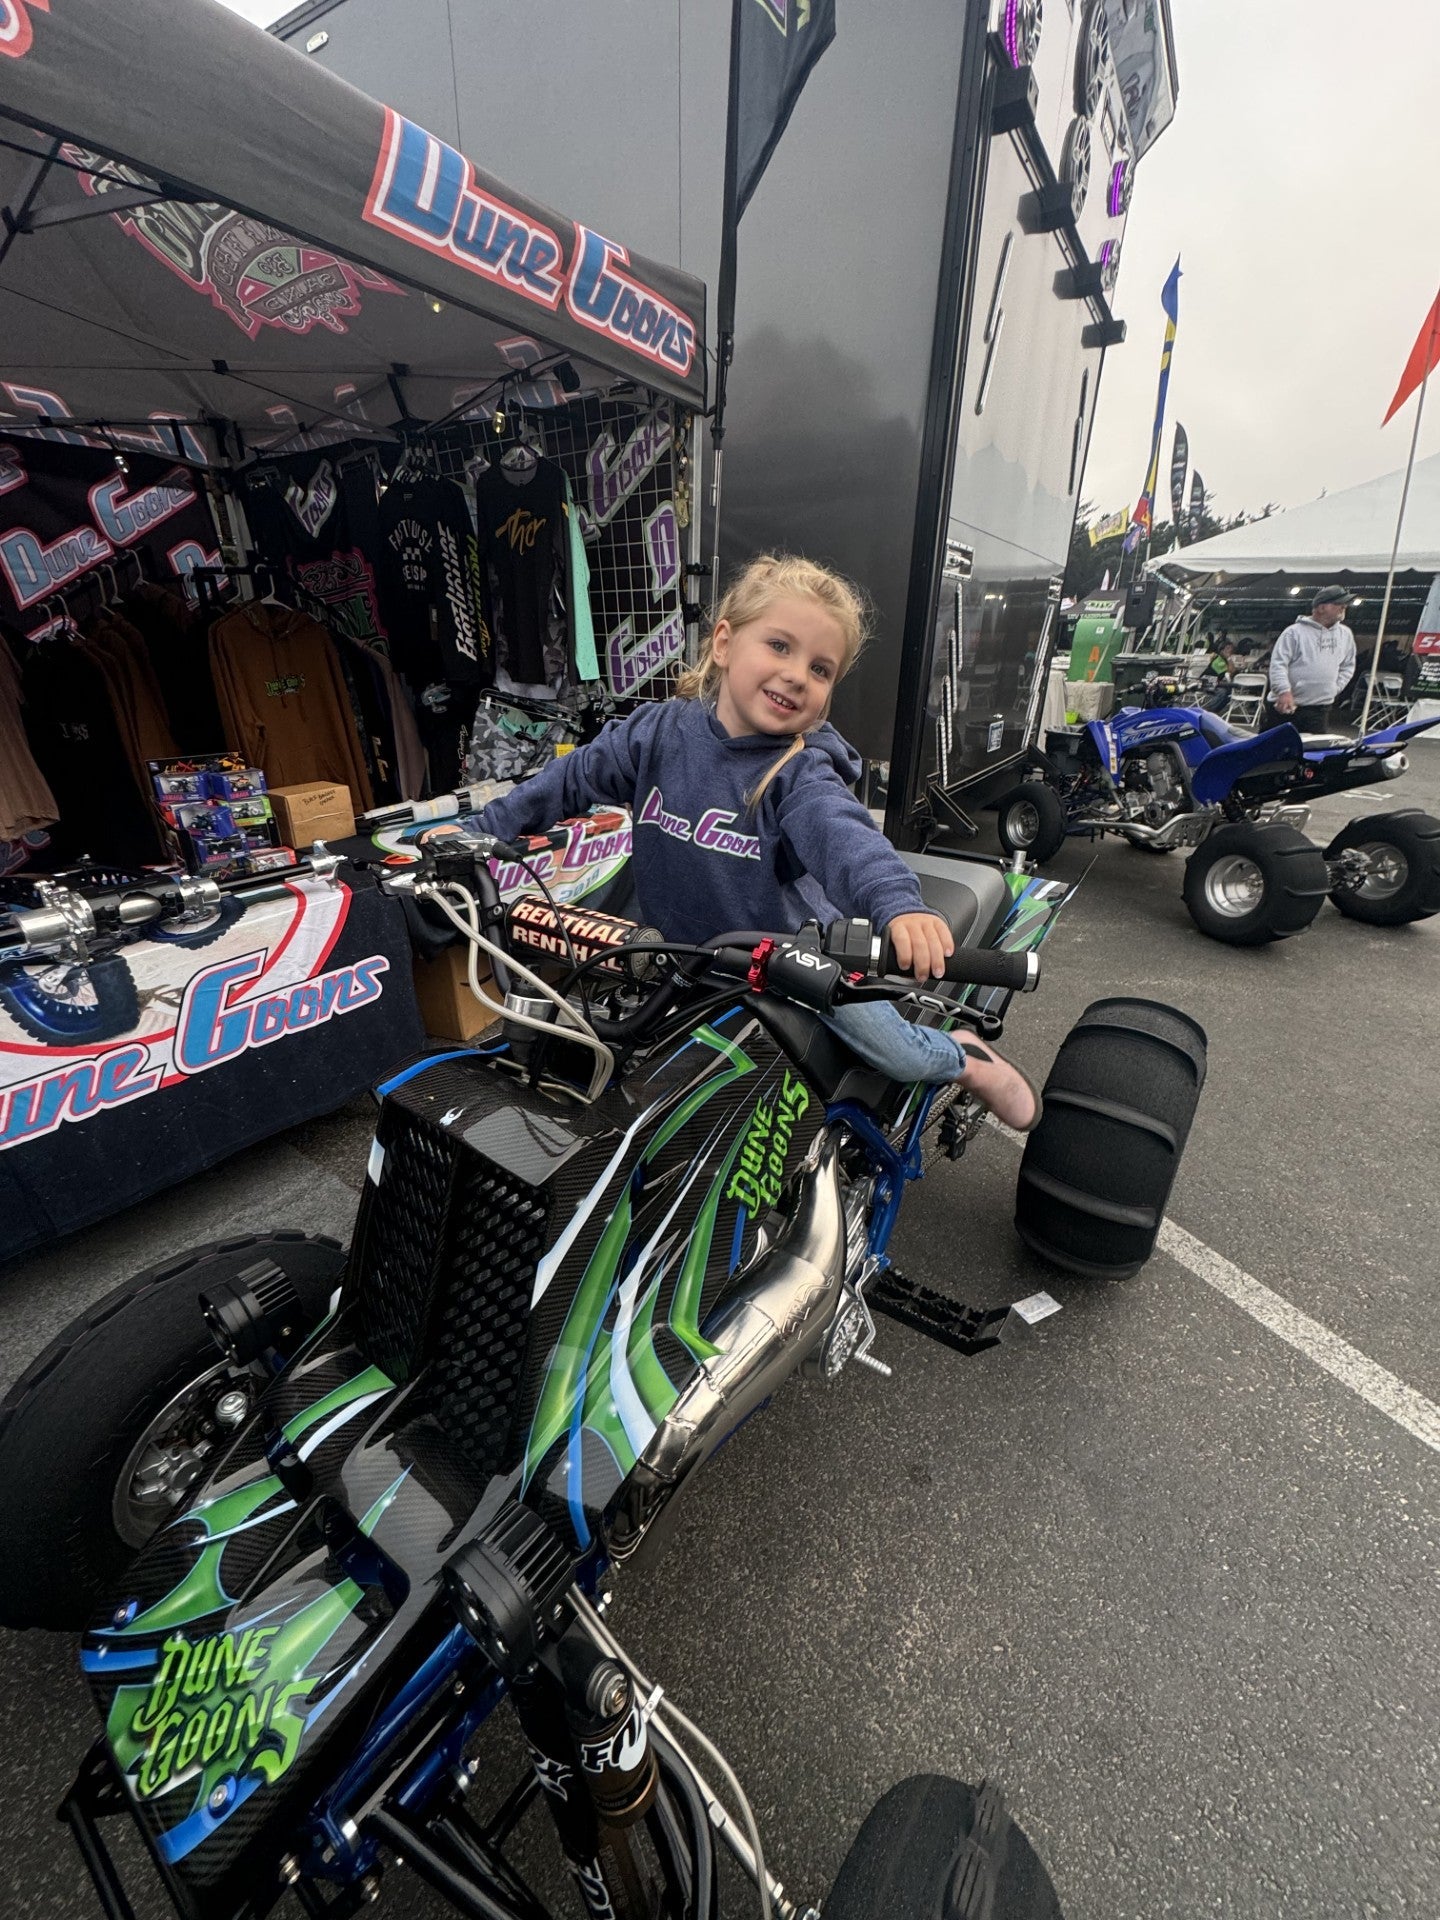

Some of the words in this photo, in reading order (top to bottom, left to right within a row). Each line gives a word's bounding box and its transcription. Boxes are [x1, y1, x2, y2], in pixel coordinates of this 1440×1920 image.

[364, 106, 564, 310] Dune
[564, 222, 697, 377] Goons
[0, 522, 115, 612] Dune
[560, 820, 633, 873] Goon
[637, 786, 693, 842] Dune
[693, 808, 761, 860] Goon
[511, 902, 626, 946] RENTHAL
[785, 949, 832, 971] ASV
[0, 1040, 167, 1150] une
[172, 947, 391, 1076] Goons
[726, 1096, 773, 1220] DUNE
[759, 1067, 810, 1207] GOONS
[132, 1625, 281, 1733] DUNE
[136, 1675, 323, 1797] GOONS
